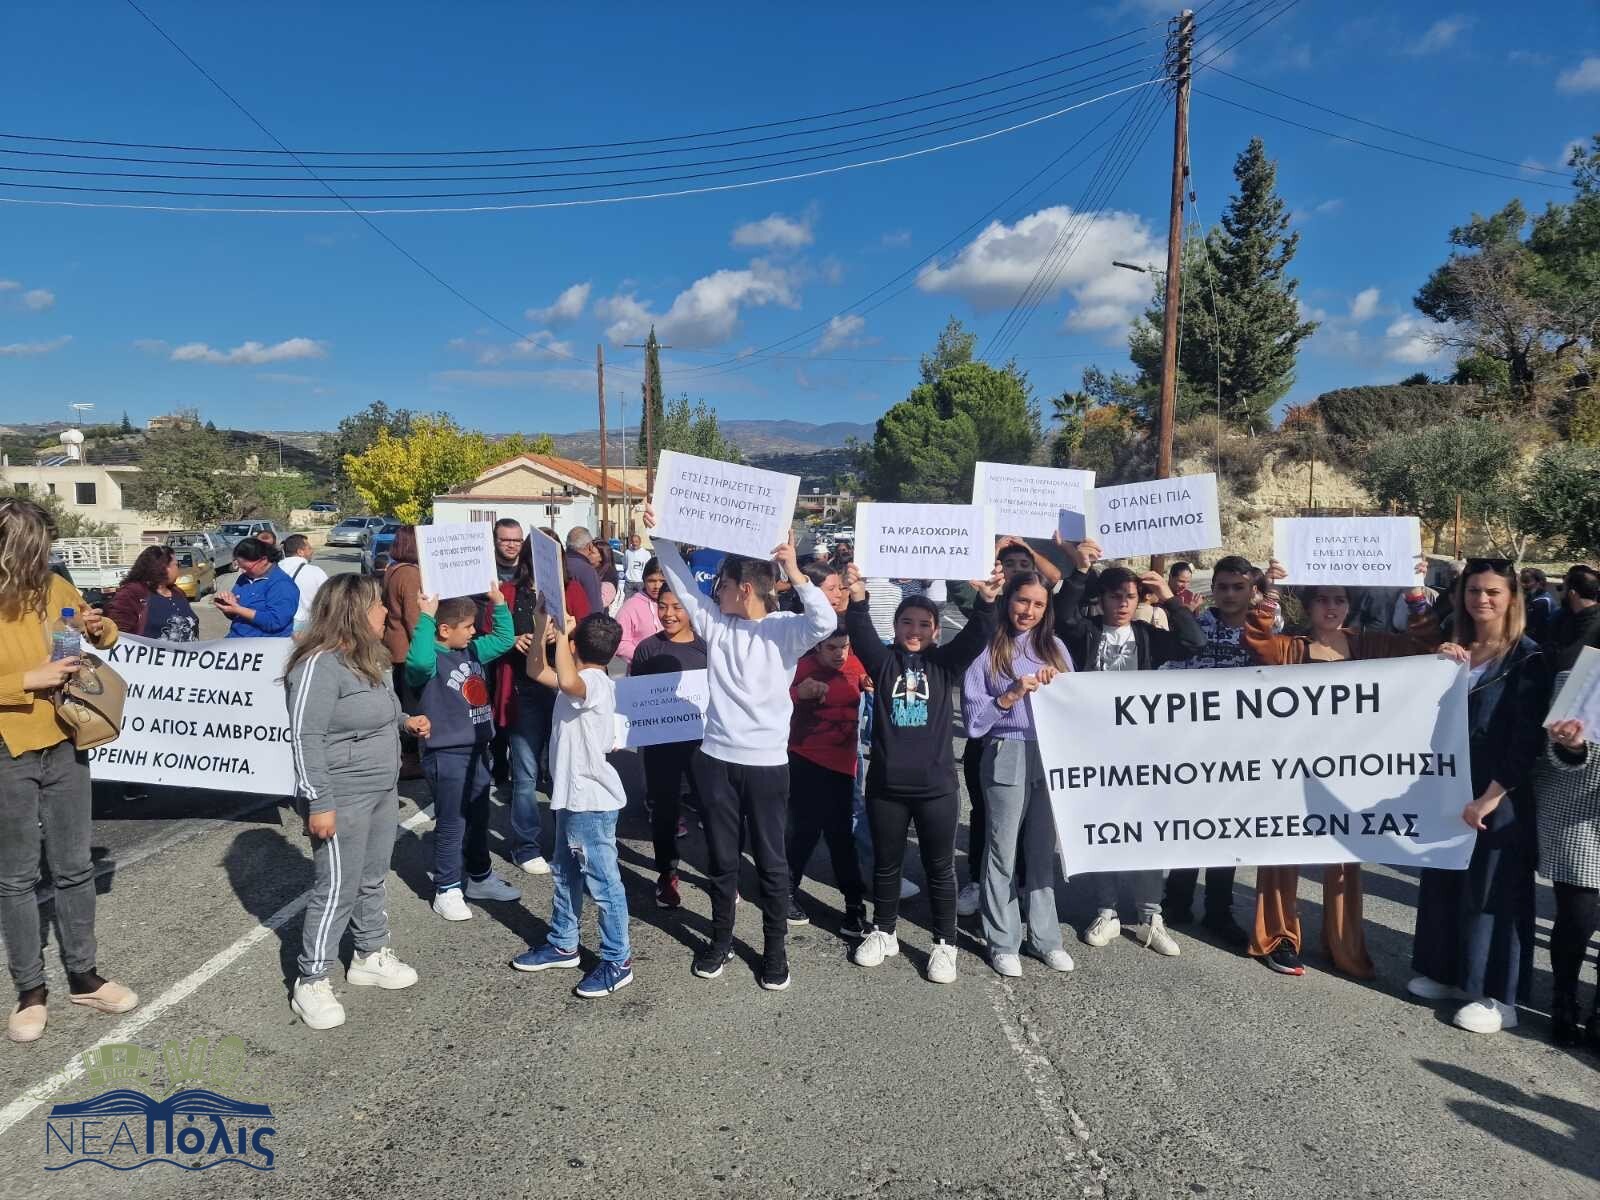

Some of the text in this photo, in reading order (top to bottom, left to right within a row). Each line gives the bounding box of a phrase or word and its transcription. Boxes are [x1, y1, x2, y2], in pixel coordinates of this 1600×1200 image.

[682, 471, 772, 498] ΕΤΣΙ ΣΤΗΡΙΖΕΤΕ ΤΙΣ
[670, 486, 777, 516] ΟΡΕΙΝΕΣ ΚΟΙΝΟΤΗΤΕΣ
[1108, 489, 1191, 510] ΦΤΑΝΕΙ ΠΙΑ
[679, 505, 706, 520] ΚΥΡΙΕ
[1100, 512, 1204, 535] Ο ΕΜΠΑΙΓΜΟΣ
[881, 526, 969, 536] ΤΑ ΚΡΑΣΟΧΩΡΙΑ
[1315, 536, 1380, 544] ΕΙΜΑΣΤΕ ΚΑΙ
[879, 545, 969, 555] ΕΙΝΑΙ ΔΙΠΛΑ ΣΑΣ
[1313, 549, 1384, 557] ΕΜΕΙΣ ΠΑΙΔΙΑ
[1306, 563, 1392, 571] ΤΟΥ ΙΔΙΟΥ ΘΕΟΥ
[108, 644, 264, 672] ΚΥΡΙΕ ΠΡΟΕΔΡΕ
[147, 685, 186, 702] ΜΑΣ
[188, 688, 253, 707] ΞΕΧΝΑΣ
[1114, 682, 1380, 725] ΚΥΡΙΕ ΝΟΥΡΗ
[132, 716, 145, 731] Ο
[150, 718, 198, 736] ΑΓΙΟΣ
[203, 722, 292, 743] ΑΜΒΡΟΣΙΟ
[625, 712, 706, 728] ΟΡΕΙΝΗ ΚΟΙΝΟΤΗΤ
[152, 752, 255, 775] ΚΟΙΝΟΤΗΤΑ.
[1049, 753, 1456, 791] ΠΕΡΙΜΕΝΟΥΜΕ ΥΛΟΠΟΙΗΣΗ
[1084, 813, 1420, 845] ΤΩΝ ΥΠΟΣΧΕΣΕΩΝ ΣΑΣ
